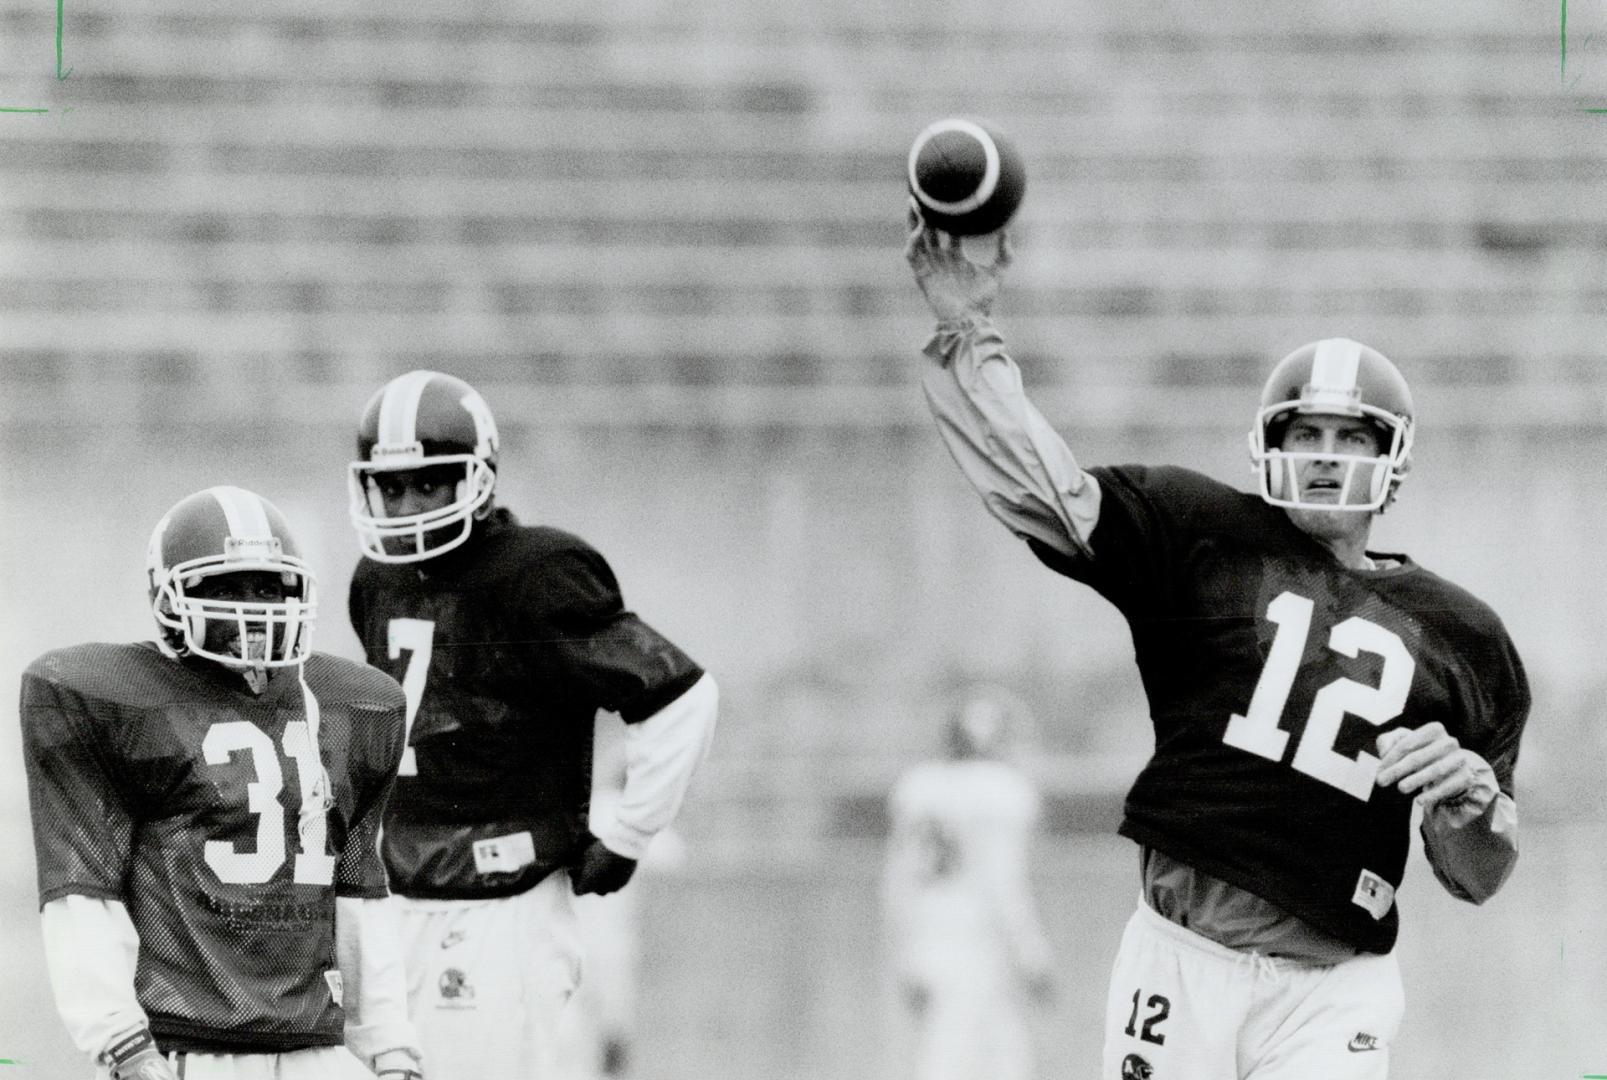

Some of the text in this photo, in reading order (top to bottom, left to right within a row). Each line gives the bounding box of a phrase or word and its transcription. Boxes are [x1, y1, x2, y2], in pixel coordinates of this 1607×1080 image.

[386, 617, 435, 776] 7
[1222, 590, 1416, 802] 12
[201, 720, 336, 885] 31
[1124, 988, 1171, 1046] 12
[1354, 1031, 1379, 1047] NIKE
